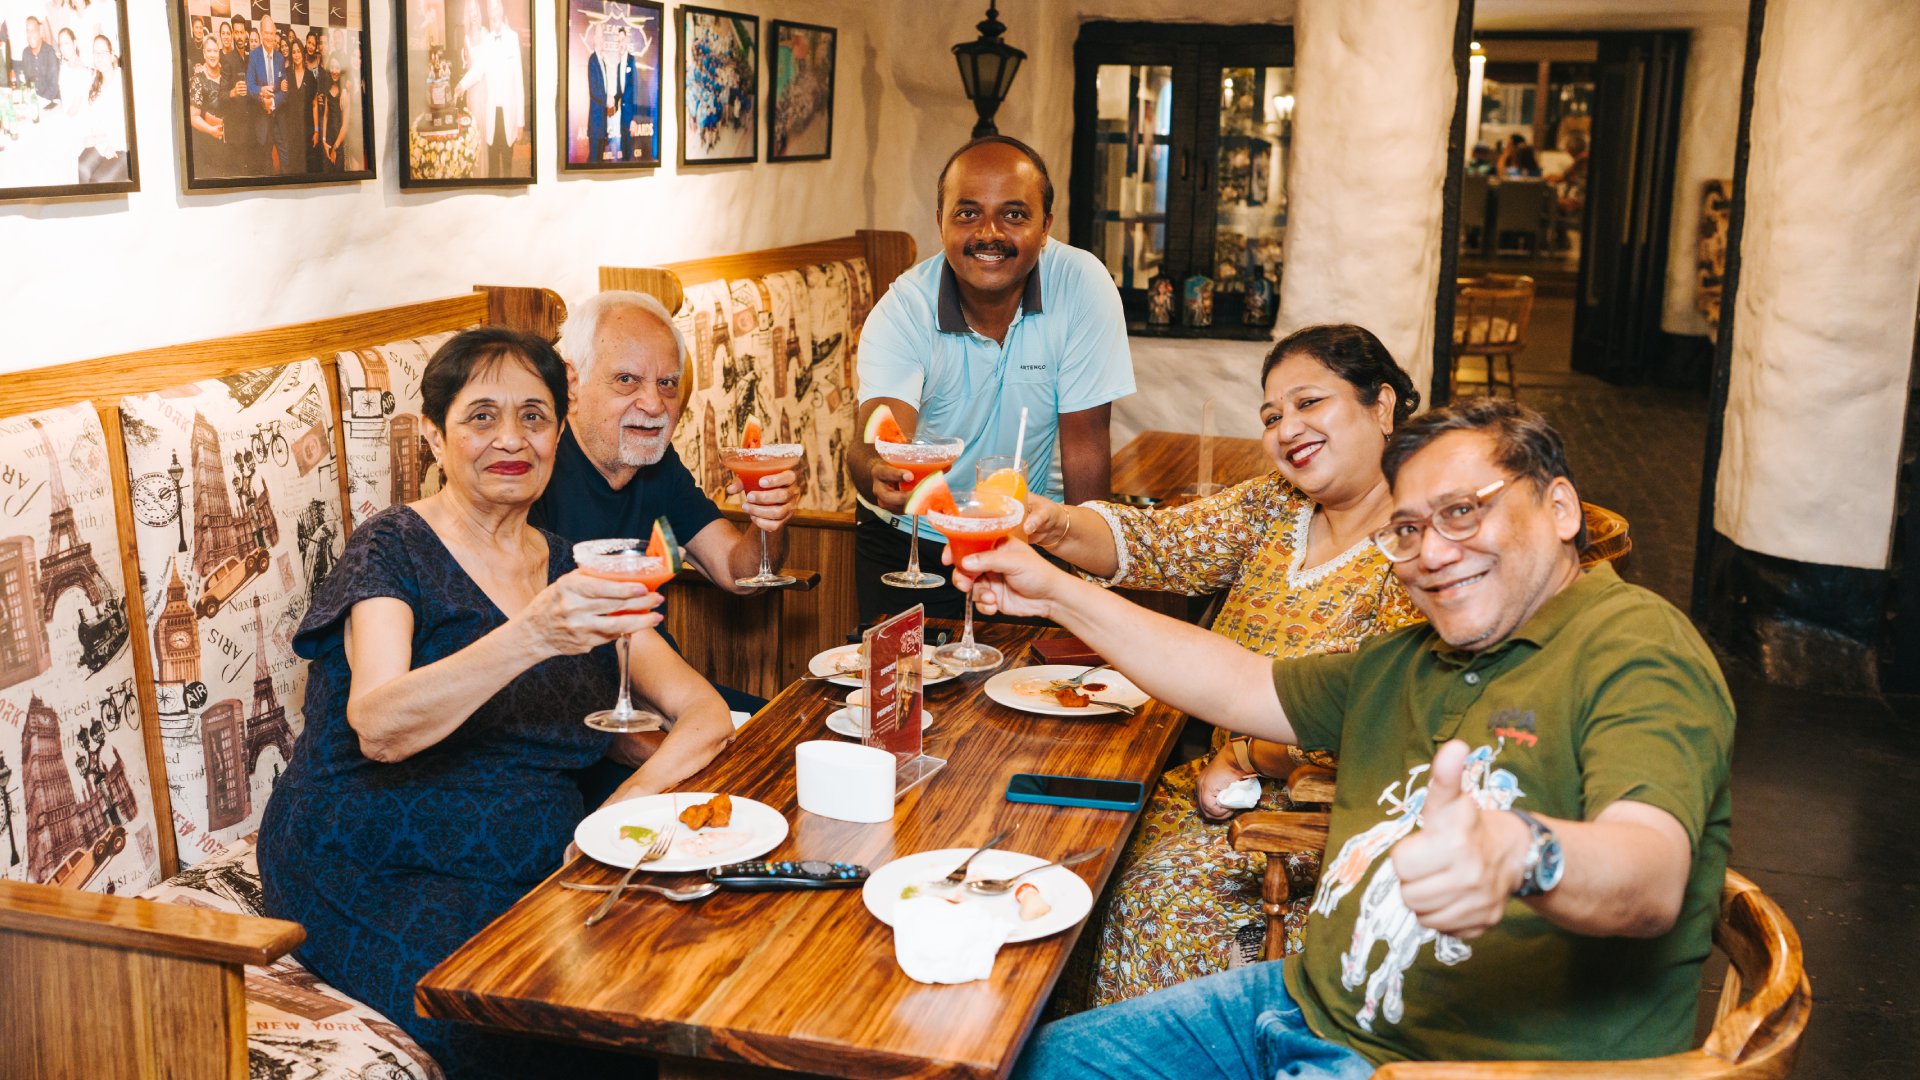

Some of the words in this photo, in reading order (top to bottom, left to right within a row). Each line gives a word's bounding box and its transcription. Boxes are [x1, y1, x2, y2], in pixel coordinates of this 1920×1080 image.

[207, 628, 254, 684] PARIS
[186, 684, 208, 708] AIR
[256, 1020, 299, 1032] NEW
[312, 1021, 364, 1032] YORK
